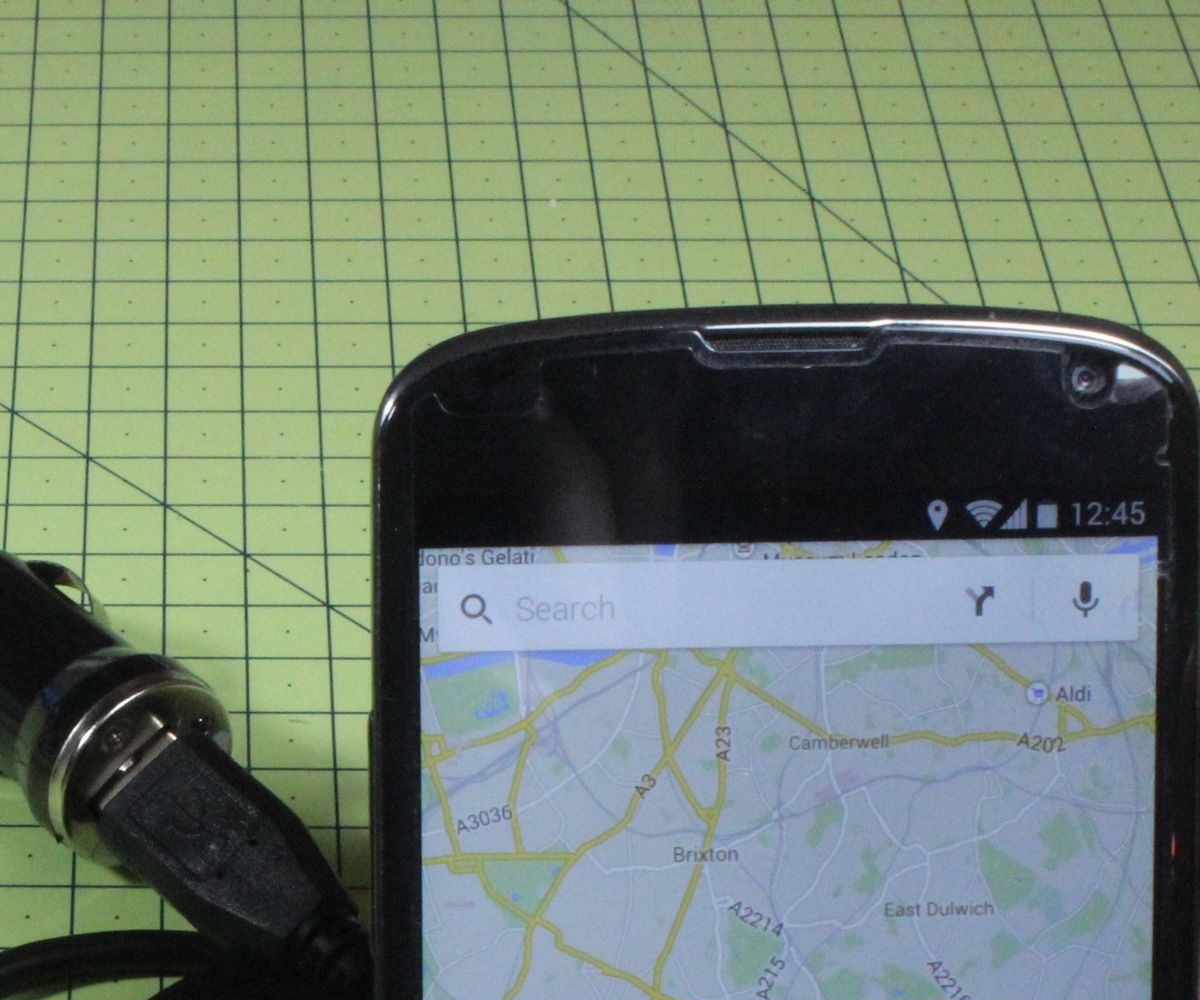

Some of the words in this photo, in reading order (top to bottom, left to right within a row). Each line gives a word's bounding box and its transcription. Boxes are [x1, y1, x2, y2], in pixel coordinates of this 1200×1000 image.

[1071, 501, 1146, 526] 12:45
[516, 594, 615, 622] Search
[1056, 686, 1092, 702] Aldi
[716, 726, 731, 762] A23
[789, 734, 889, 751] Camberwell
[1017, 733, 1066, 753] A202
[635, 774, 657, 800] A3
[456, 804, 513, 834] A3036
[673, 846, 739, 863] Brixton
[728, 900, 784, 937] A2214
[884, 903, 921, 918] East
[927, 901, 994, 917] Dulwich
[756, 957, 786, 1000] A215
